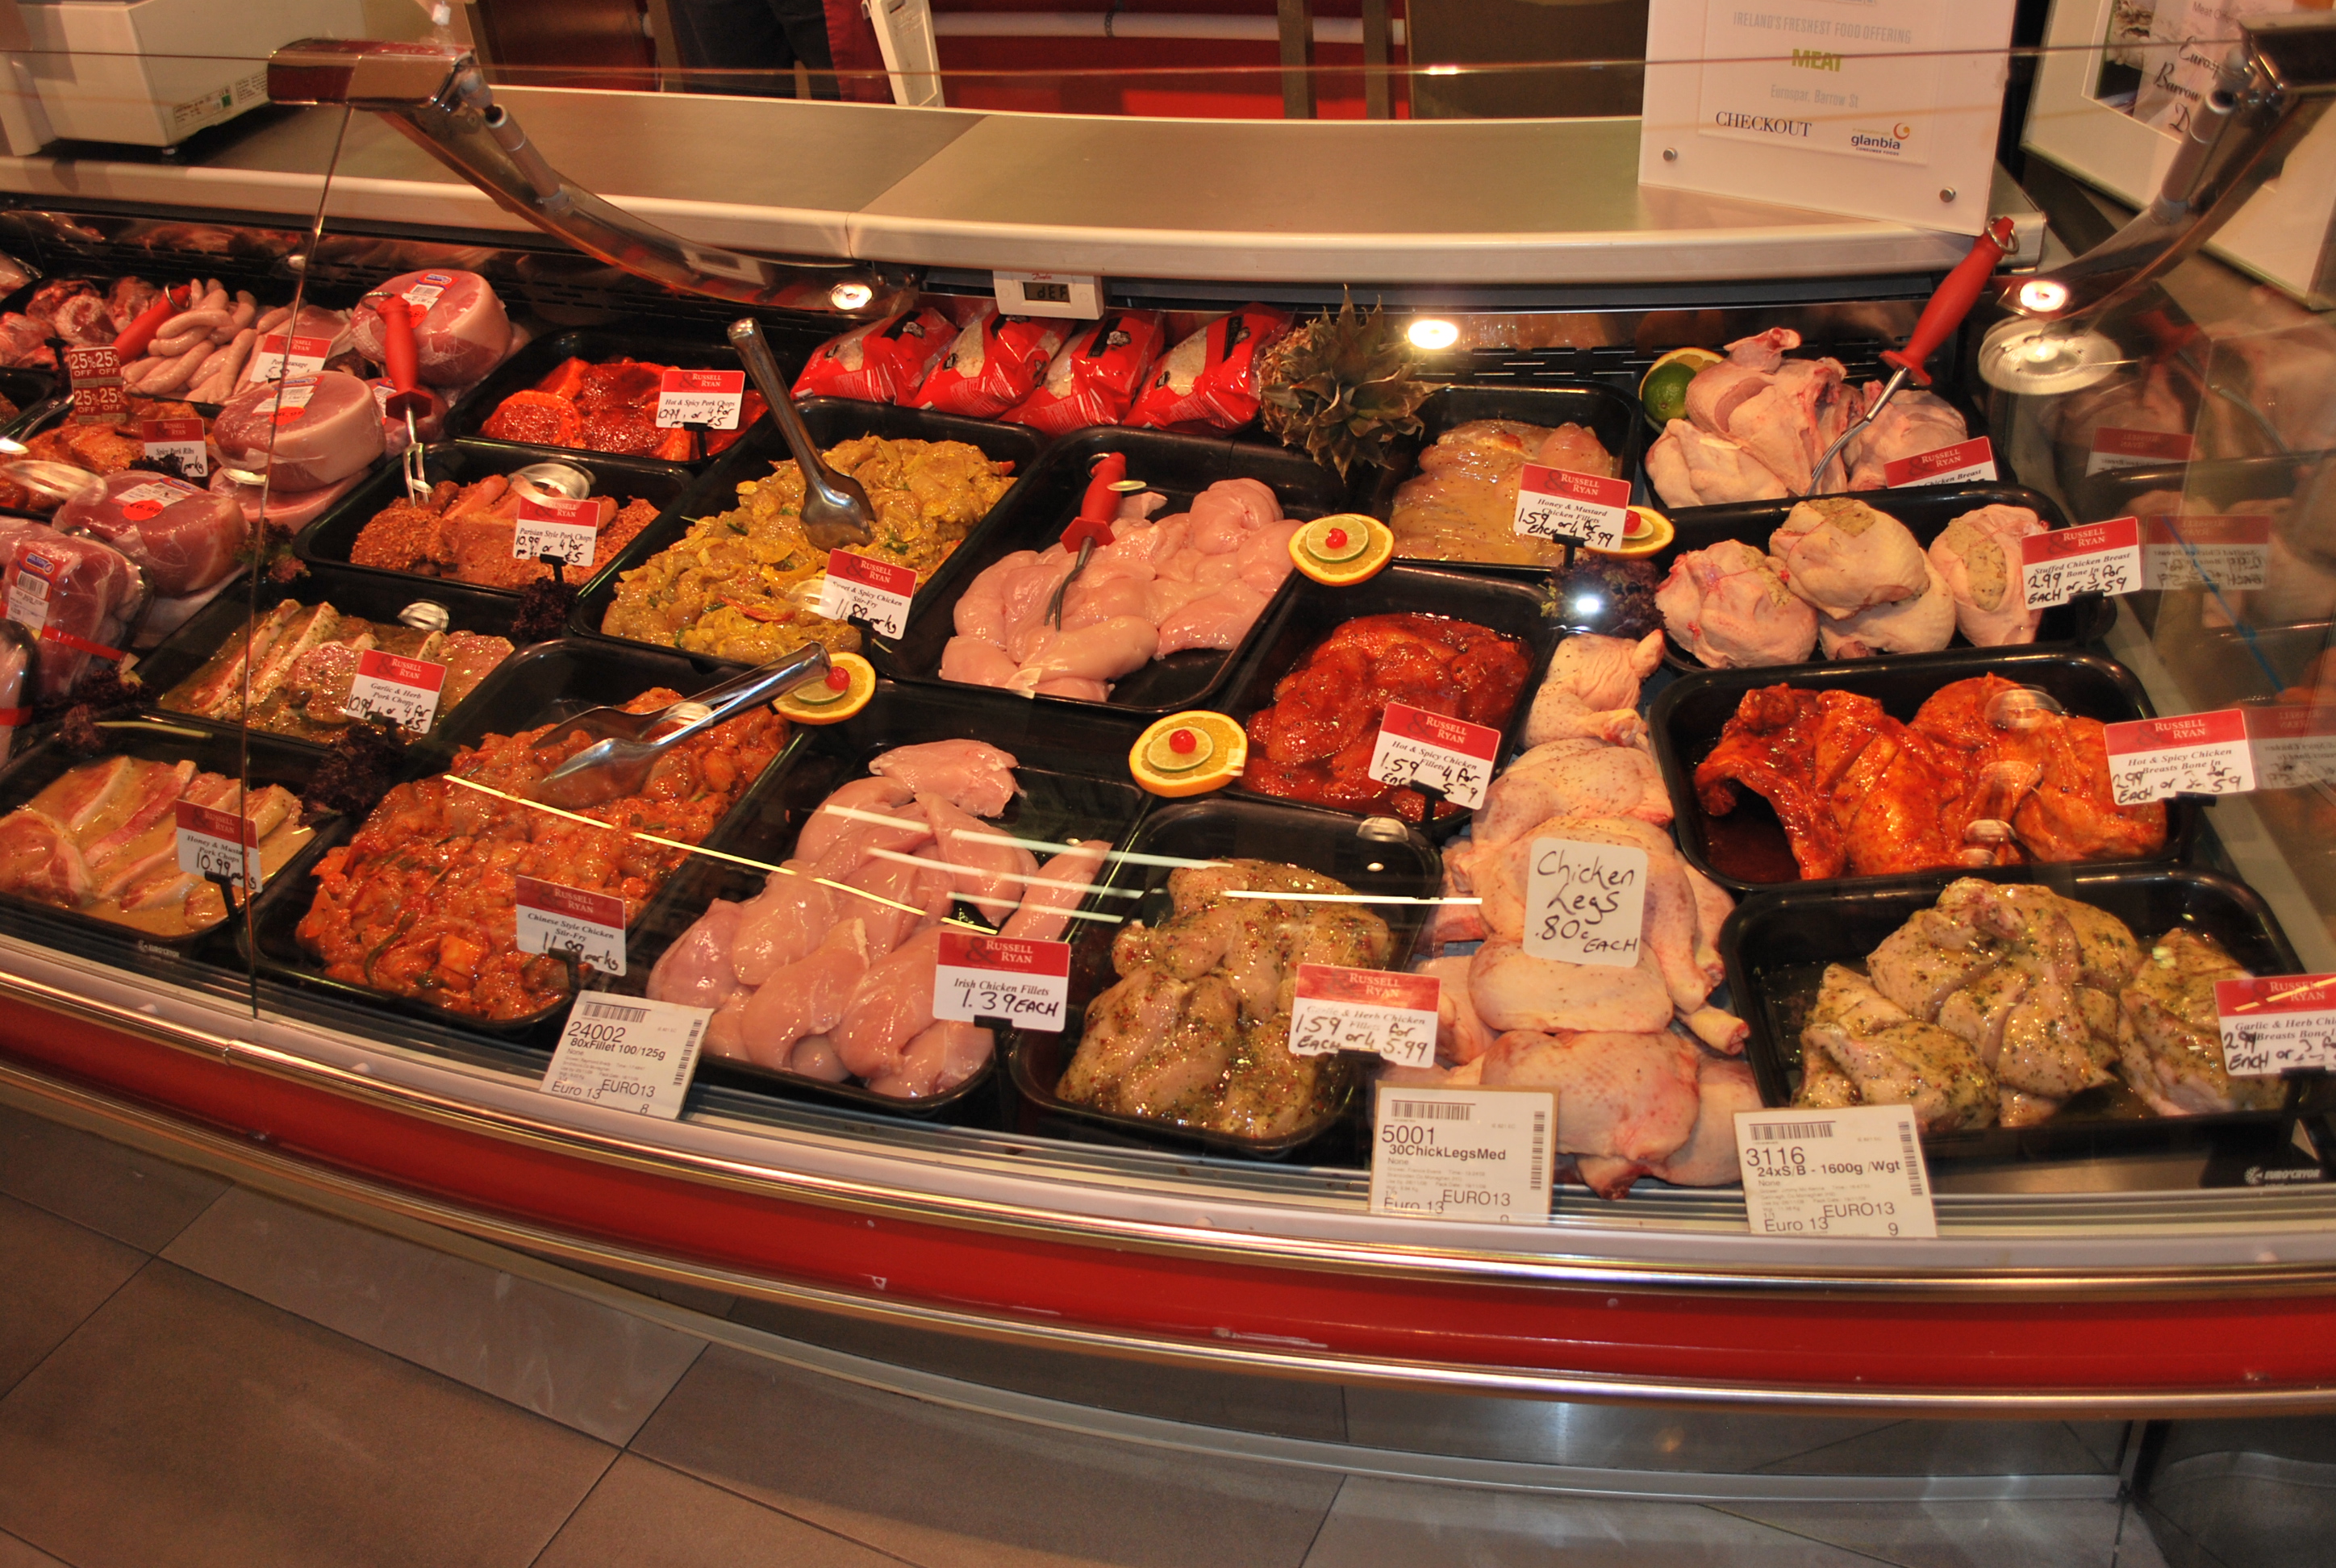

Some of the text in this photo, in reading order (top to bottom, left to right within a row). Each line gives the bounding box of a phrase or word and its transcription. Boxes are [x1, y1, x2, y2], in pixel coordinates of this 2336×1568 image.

[1733, 12, 1911, 44] IRELAND'S FRESHEST FOOD OFFERING
[1792, 48, 1843, 72] MEAT
[2154, 61, 2202, 102] Barrow
[1815, 90, 1846, 106] Barrow
[1849, 94, 1858, 108] St
[1716, 111, 1812, 137] CHECKOUT
[1851, 135, 1900, 149] glanbia
[71, 353, 96, 369] 25%
[1921, 449, 1961, 464] RUSSELL
[1936, 456, 1962, 468] RYAN
[1561, 473, 1600, 488] RUSSELL
[1957, 469, 1981, 480] Breast
[1572, 484, 1599, 495] RYAN
[557, 509, 576, 517] RYAN
[1537, 498, 1608, 517] Honey Mustard
[1541, 507, 1600, 523] Chicken Fillets
[520, 528, 543, 536] Parisian
[575, 534, 593, 543] Chops
[2063, 528, 2105, 541] RUSSELL
[2078, 536, 2106, 547] RYAN
[861, 560, 892, 576] RUSSELL
[2034, 553, 2131, 575] Stuffed Chicken Breast
[870, 571, 891, 583] RYAN
[2066, 569, 2088, 578] Bone
[832, 581, 903, 607] Sweet Spicy Chicken
[2027, 588, 2062, 604] EACH
[853, 596, 878, 608] Stir-Fry
[392, 658, 422, 672] RUSSELL
[399, 668, 420, 679] RYAN
[371, 682, 421, 699] Garlic Herb
[373, 692, 414, 706] Pork Chops
[1426, 716, 1467, 736] RUSSELL
[2155, 719, 2205, 732] RUSSELL
[1437, 729, 1466, 744] RYAN
[2172, 728, 2206, 740] RYAN
[1391, 741, 1407, 751] Hot
[1419, 749, 1441, 761] Spicy
[1443, 755, 1478, 770] Chicken
[2128, 749, 2233, 766] Hot Spicy Chicken
[1420, 759, 1445, 771] Fillets
[2142, 765, 2178, 774] Breasts
[2181, 761, 2207, 769] Bone
[205, 811, 235, 826] RUSSELL
[215, 822, 235, 833] RYAN
[187, 835, 210, 847] Honey
[199, 847, 240, 863] Pork Chops
[1537, 849, 1634, 890] Chicken
[554, 888, 594, 905] RUSSELL
[1546, 882, 1620, 925] Legs
[568, 900, 594, 913] RYAN
[528, 913, 614, 940] Chinese Style Chicken
[555, 928, 587, 942] Stir-Fry
[986, 940, 1033, 954] RUSSELL
[1583, 937, 1637, 953] EACH
[1001, 952, 1032, 963] RYAN
[954, 978, 1050, 996] Irish Chicken Fillets
[1349, 973, 1401, 987] RUSSELL
[1366, 985, 1400, 998] RYAN
[2291, 991, 2325, 1002] RYAN
[1354, 1010, 1380, 1020] Herb
[1383, 1013, 1426, 1025] Chicken
[2235, 1019, 2313, 1031] Garlic Herb
[567, 1021, 626, 1043] 24002
[1345, 1032, 1365, 1042] or
[1389, 1023, 1415, 1037] for
[1349, 1020, 1381, 1032] Fillets
[2257, 1032, 2296, 1040] Breasts
[567, 1048, 584, 1057] None
[569, 1037, 666, 1061] 80xFillet 100/125g
[1383, 1039, 1428, 1062] 5.99
[2276, 1049, 2294, 1059] or
[551, 1081, 602, 1100] Euro 13
[601, 1078, 656, 1098] EURO13
[640, 1103, 649, 1114] 8
[1381, 1124, 1435, 1145] 5001
[1388, 1144, 1506, 1161] 30ChickLegsMed
[1746, 1146, 1805, 1167] 3116
[1387, 1157, 1409, 1166] None
[1757, 1166, 1807, 1178] 24xS/B
[1821, 1163, 1863, 1176] 1600g
[1442, 1189, 1511, 1207] EURO13
[1426, 1201, 1445, 1215] 13
[1823, 1202, 1895, 1219] EURO13
[1764, 1216, 1829, 1232] Euro 13
[1888, 1222, 1898, 1236] 9
